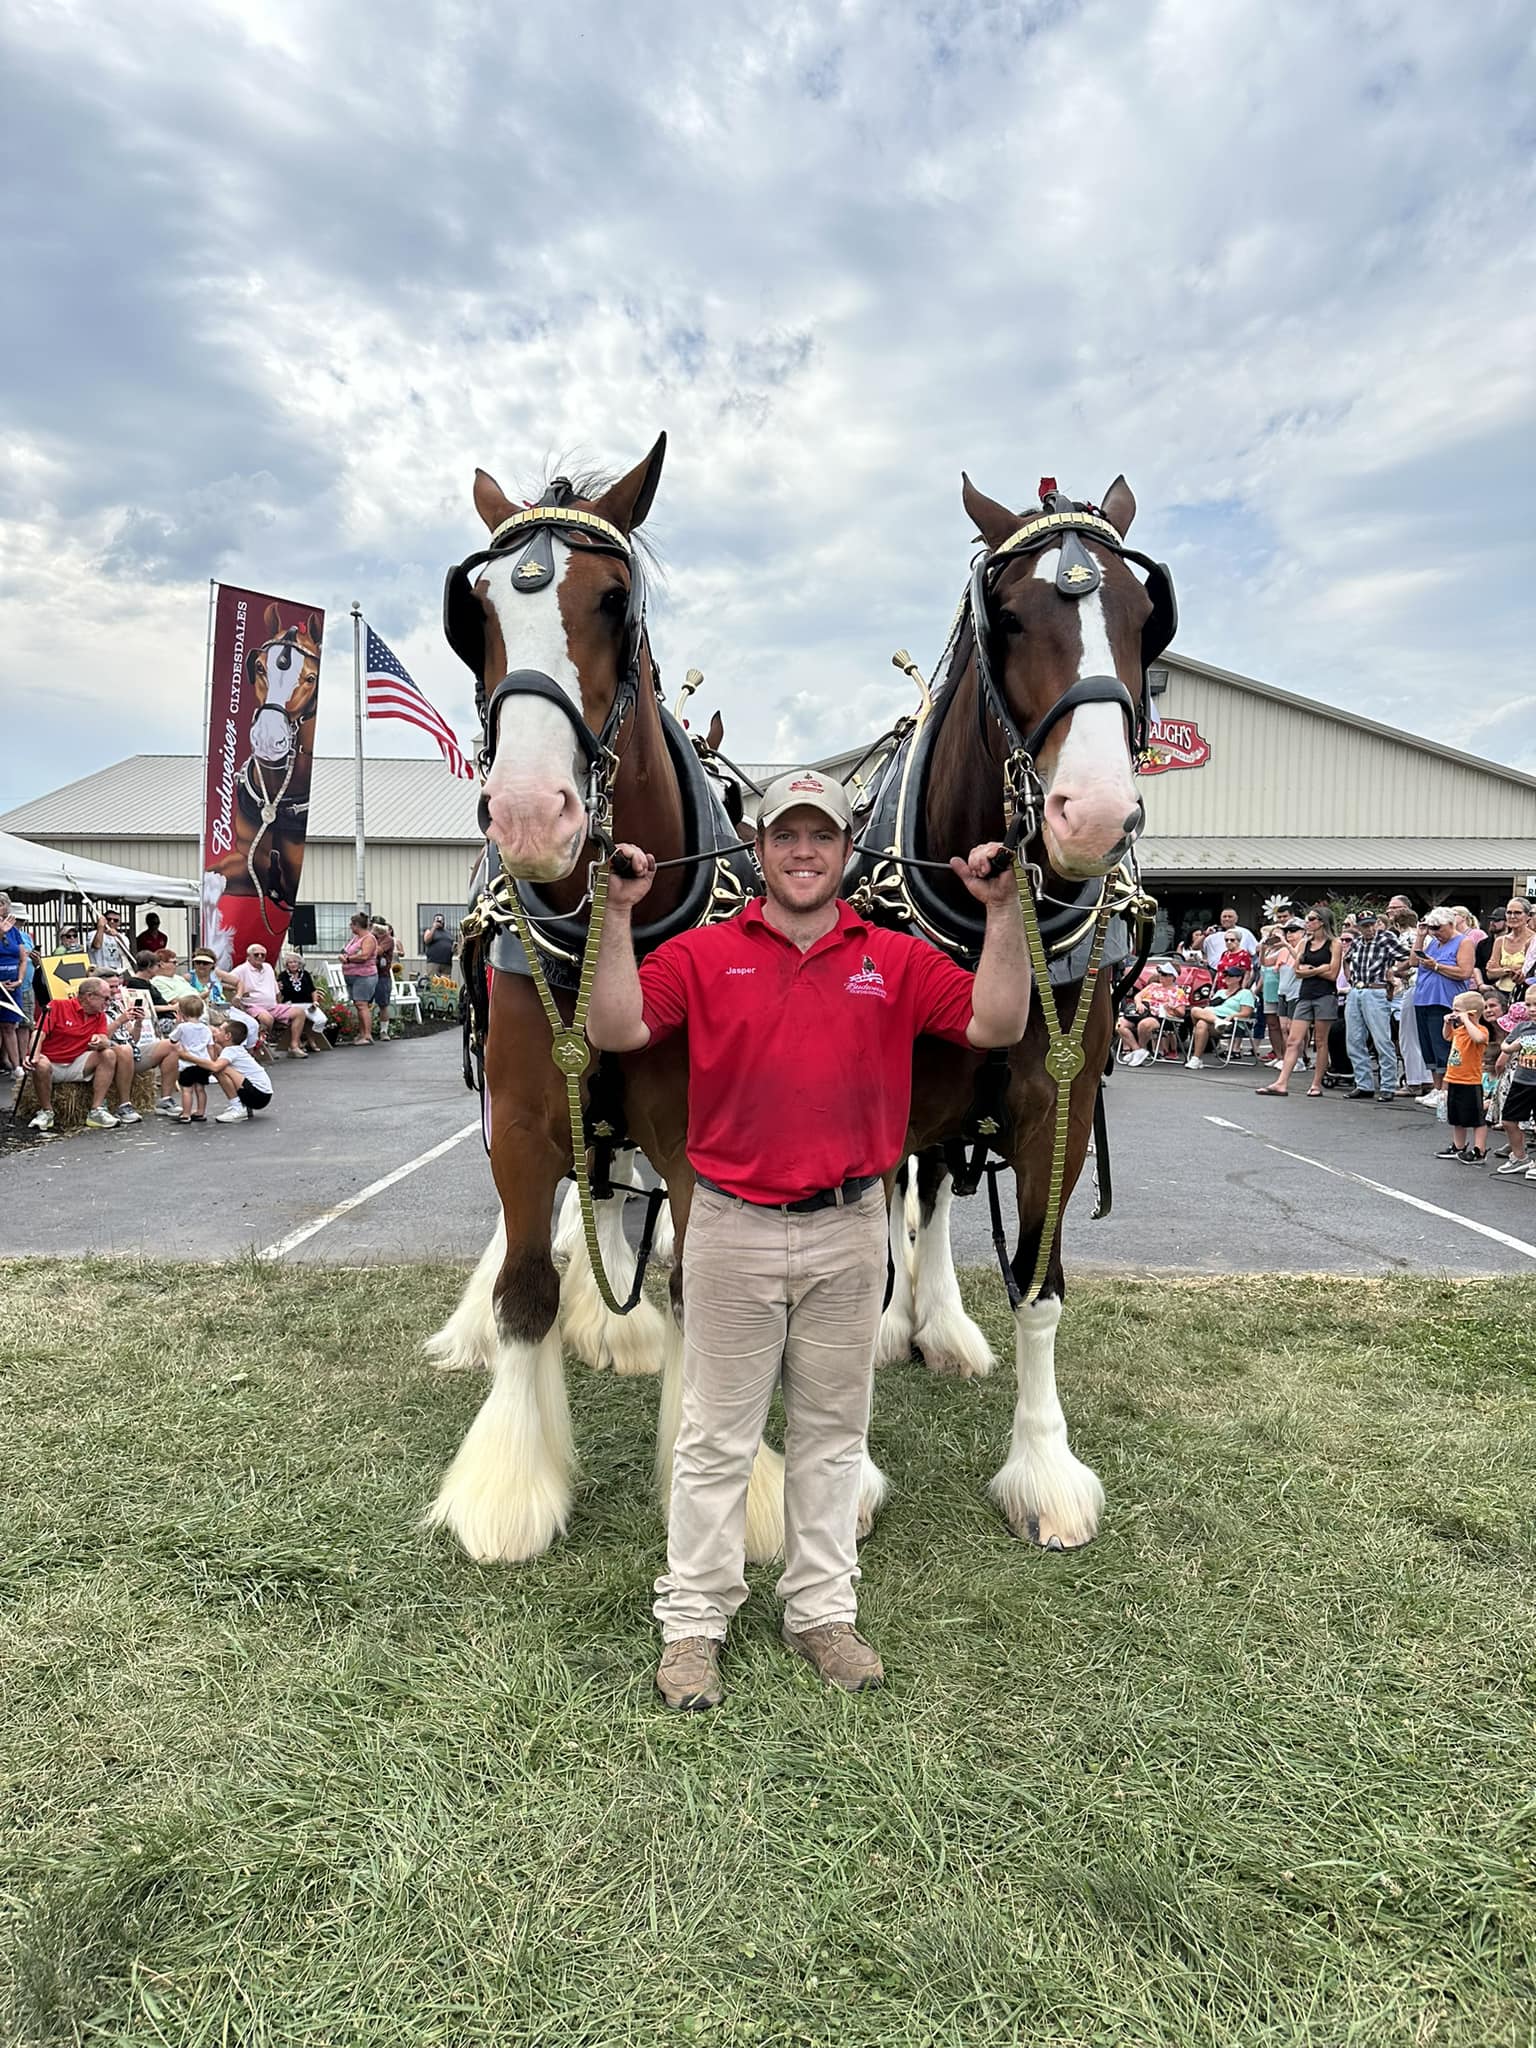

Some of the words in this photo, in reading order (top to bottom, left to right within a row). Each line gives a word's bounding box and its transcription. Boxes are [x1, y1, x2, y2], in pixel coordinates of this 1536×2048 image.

[212, 719, 237, 854] Budweiser
[229, 601, 248, 714] CLYDESDALES
[1149, 723, 1191, 749] AUGH'S
[725, 966, 757, 976] Jasper
